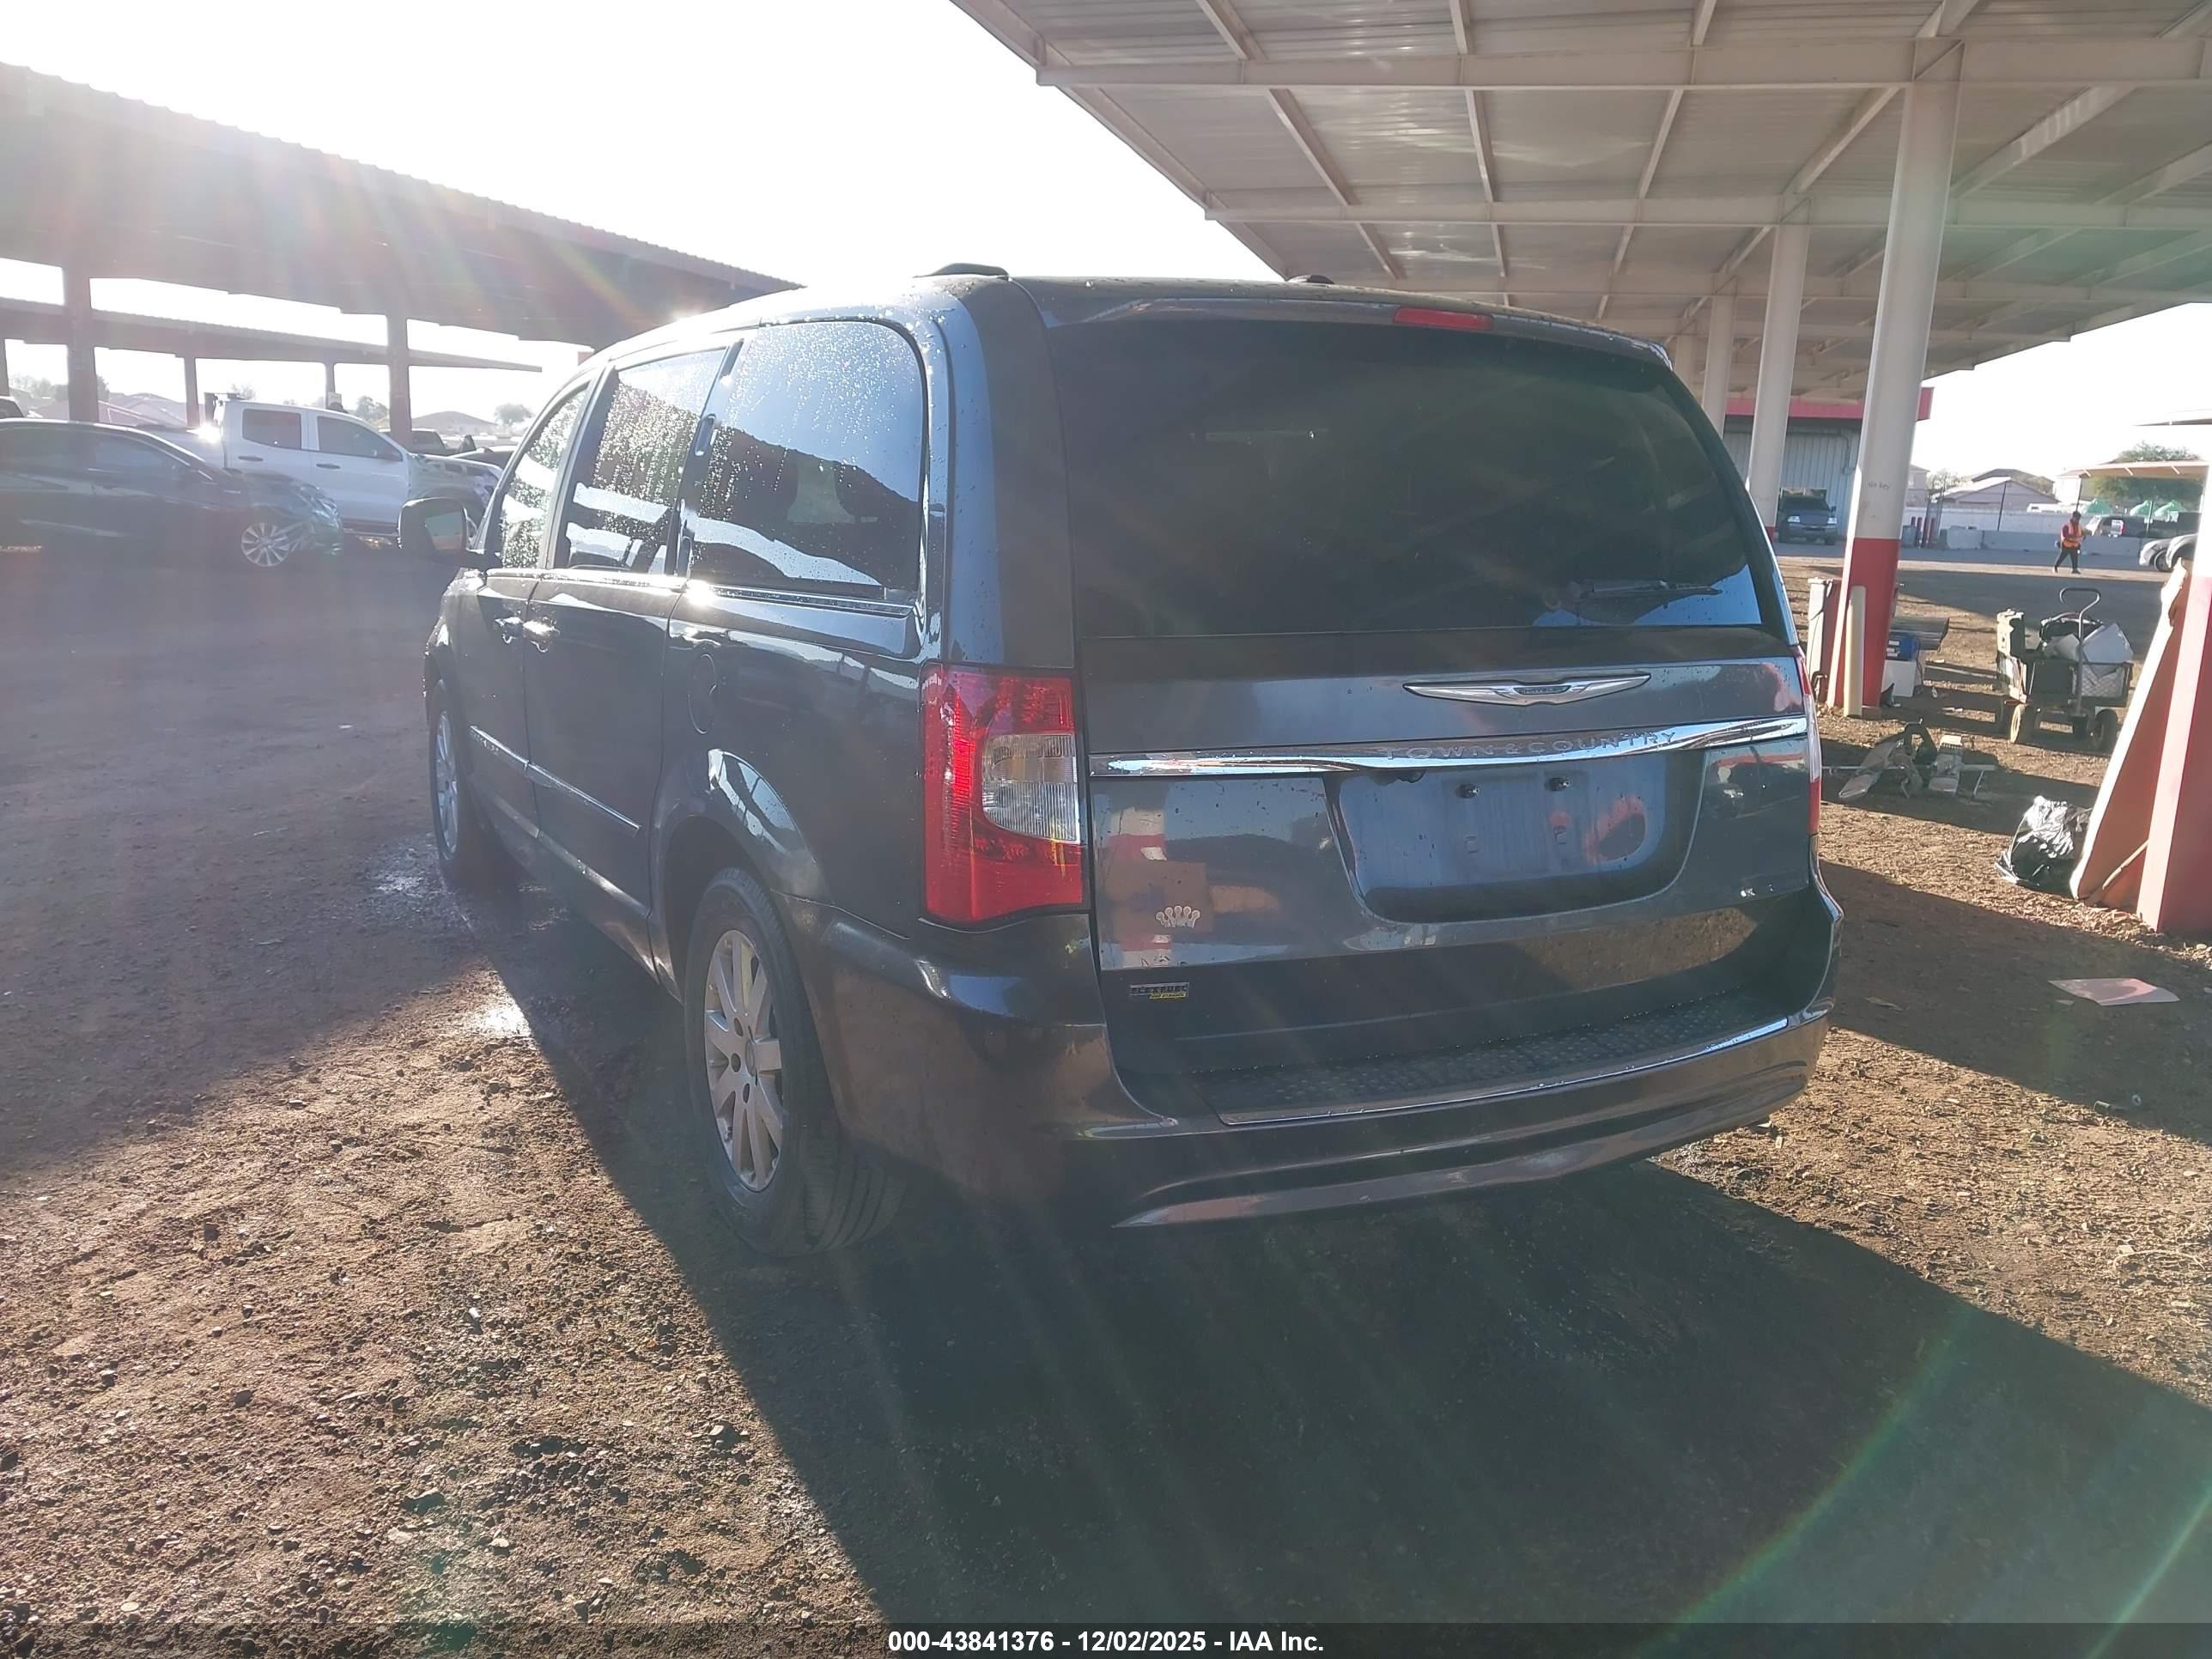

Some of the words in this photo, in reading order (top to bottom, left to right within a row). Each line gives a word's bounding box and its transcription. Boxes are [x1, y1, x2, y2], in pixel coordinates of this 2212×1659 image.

[1386, 745, 1494, 761] TOWN
[1504, 743, 1519, 756] &
[1528, 731, 1676, 754] COUNTRY
